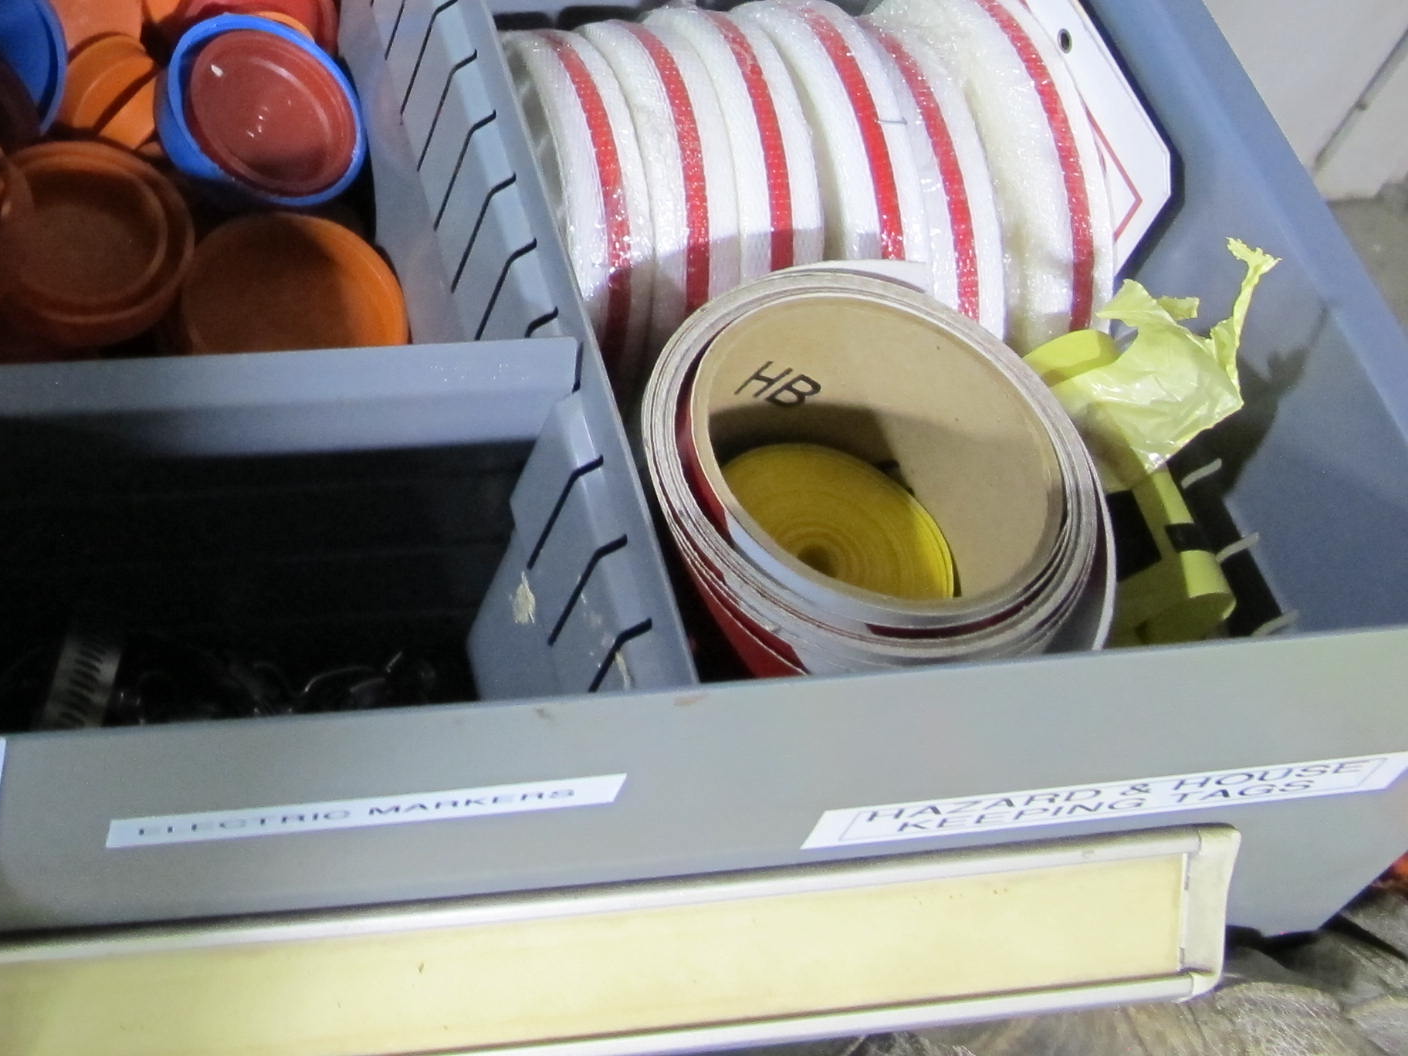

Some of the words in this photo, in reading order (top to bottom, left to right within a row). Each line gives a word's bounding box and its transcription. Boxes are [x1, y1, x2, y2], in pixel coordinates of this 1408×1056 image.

[733, 360, 823, 409] HB
[138, 809, 352, 836] ELECTRIC
[367, 787, 577, 817] MARKERS
[866, 788, 1102, 823] HAZARD
[1119, 783, 1151, 796] &
[1172, 759, 1370, 792] HOUSE
[896, 797, 1146, 832] KEEPING
[1176, 780, 1315, 804] TAGS
